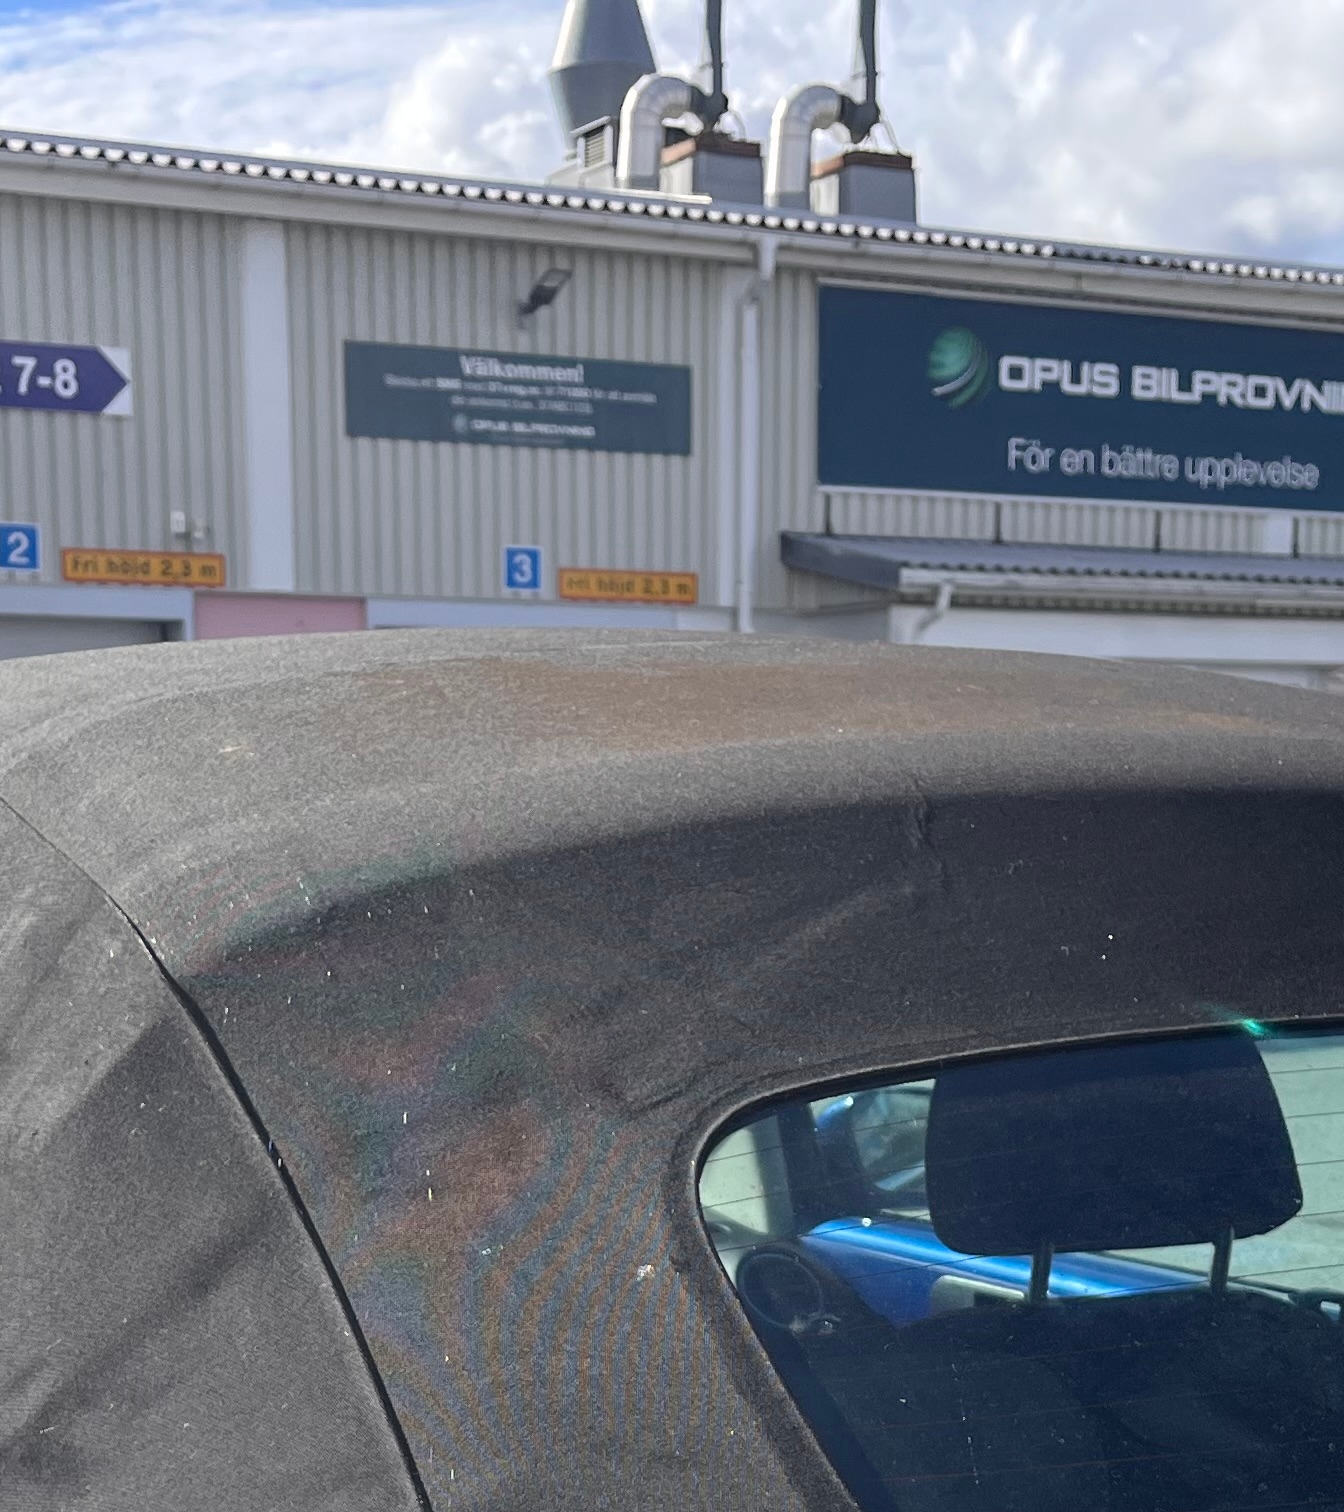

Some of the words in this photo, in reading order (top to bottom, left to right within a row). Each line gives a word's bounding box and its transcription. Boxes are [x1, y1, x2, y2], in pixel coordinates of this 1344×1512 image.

[11, 354, 80, 400] 7-8
[997, 353, 1121, 398] OPUS
[1006, 435, 1054, 473] För
[1059, 446, 1095, 476] en
[1099, 442, 1179, 482] bättre
[1184, 450, 1321, 491] upplevelse
[7, 530, 31, 565] 2
[511, 553, 533, 584] 3
